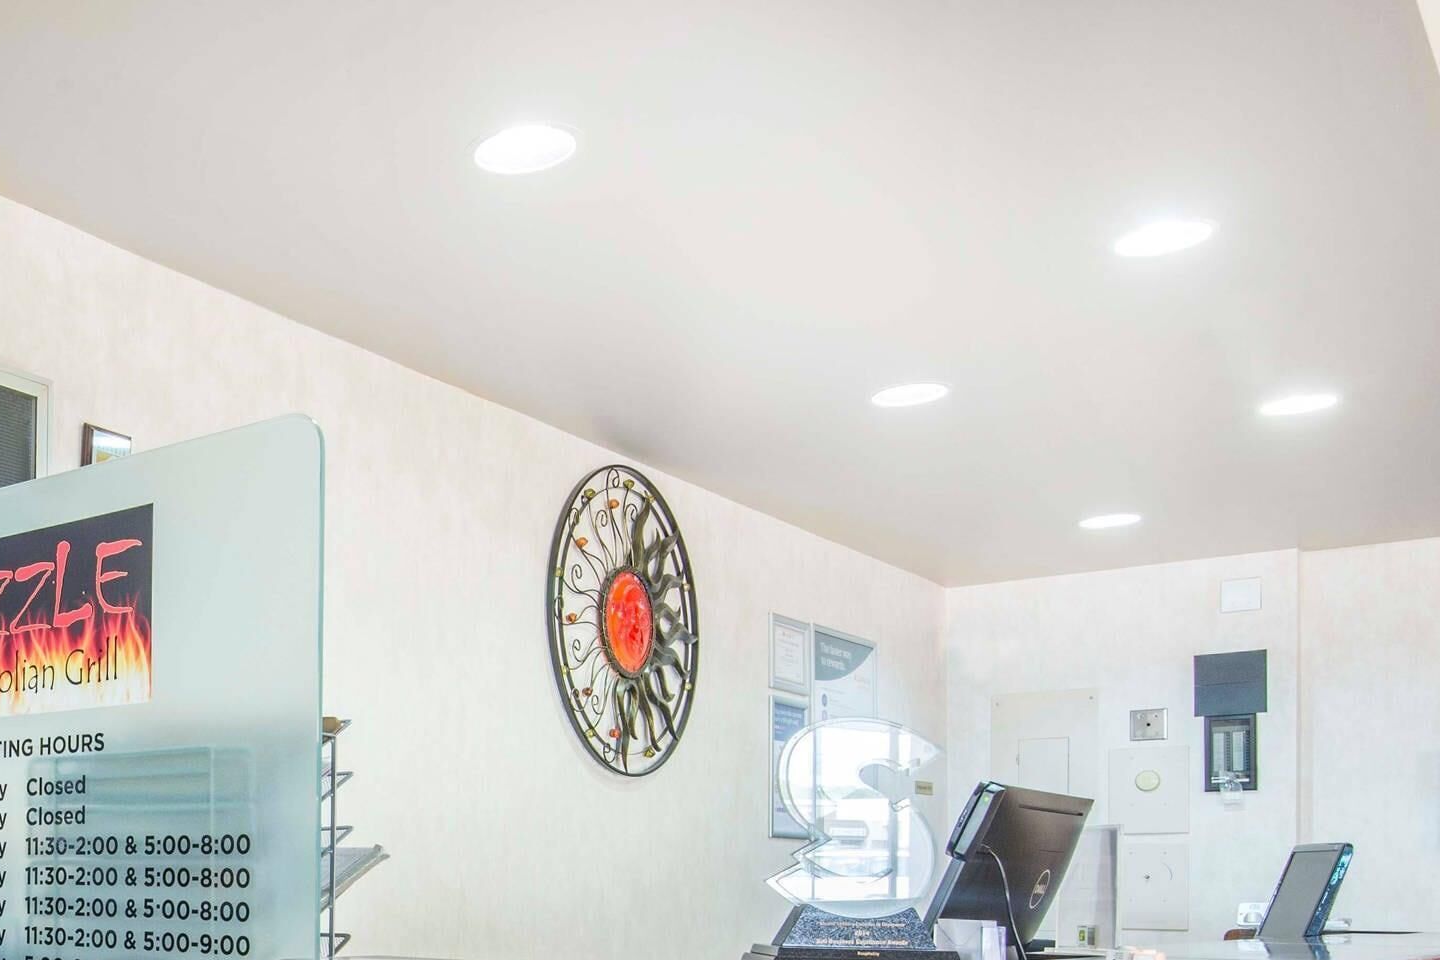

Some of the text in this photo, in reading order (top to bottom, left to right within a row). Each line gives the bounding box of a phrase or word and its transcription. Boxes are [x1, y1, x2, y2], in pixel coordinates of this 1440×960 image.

[65, 635, 119, 686] Grill
[40, 732, 105, 756] HOURS
[26, 774, 86, 797] Closed
[26, 805, 86, 826] Closed
[25, 835, 118, 856] 11:30-2:00
[124, 836, 138, 855] &
[144, 833, 251, 856] 5:00-8:00
[25, 866, 117, 887] 11:30-2:00
[124, 867, 138, 887] &
[144, 866, 251, 889] 5:00-8:00
[24, 896, 117, 917] 11:30-2:00
[124, 899, 138, 918] &
[143, 898, 250, 922] 5:00-8:00
[24, 926, 117, 949] 11:30-2:00
[123, 930, 137, 950] &
[143, 930, 250, 956] 5:00-9:00
